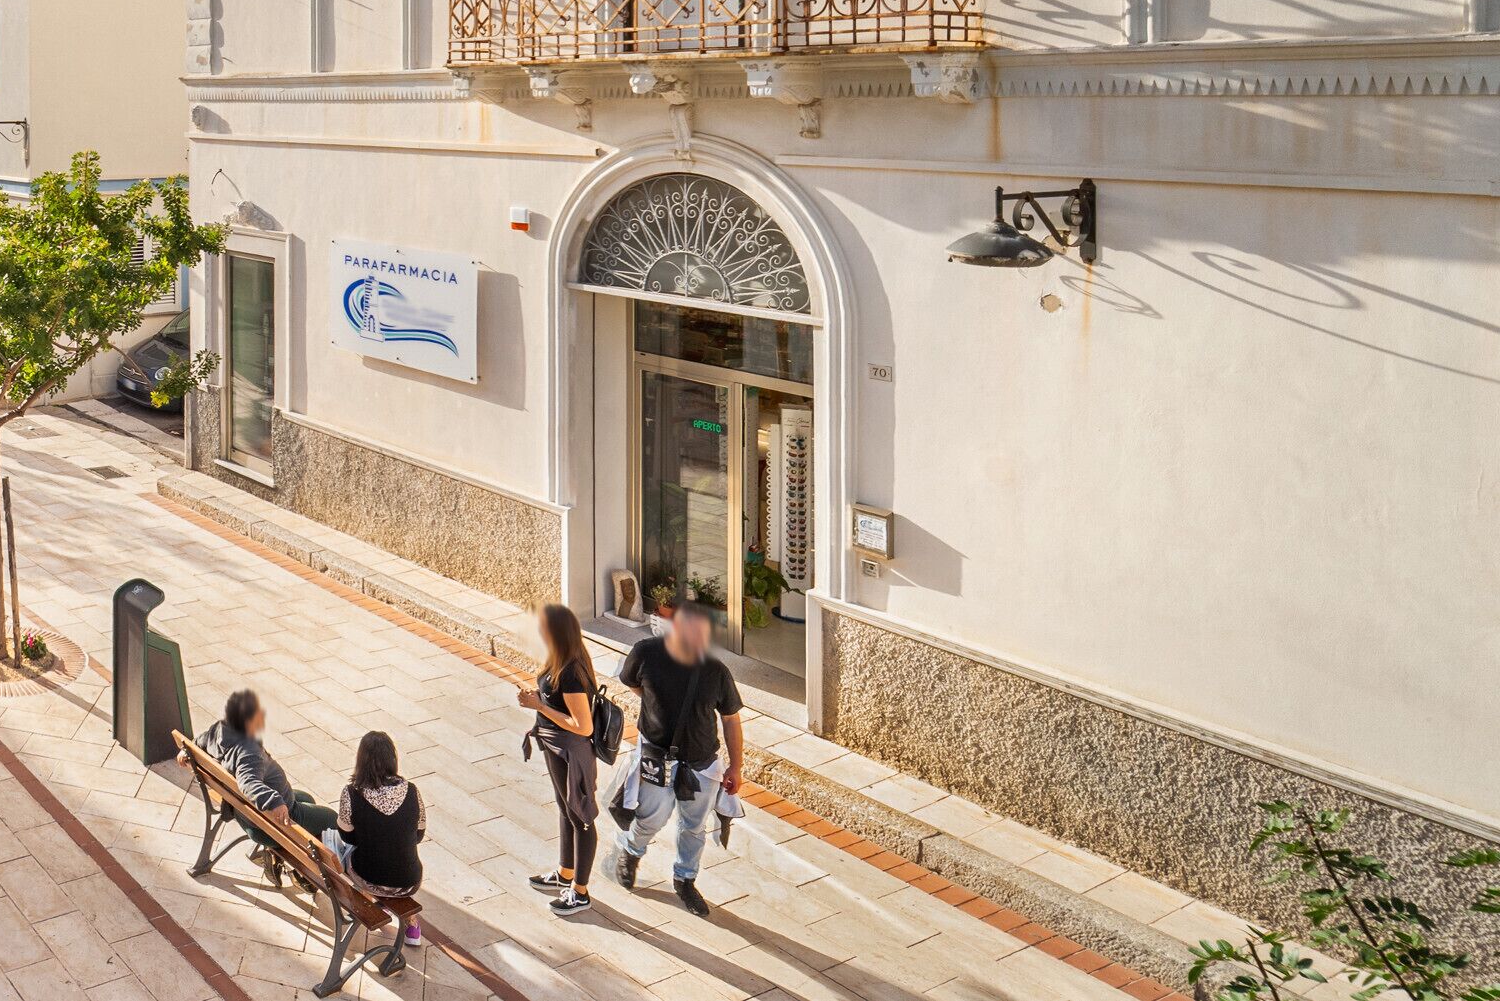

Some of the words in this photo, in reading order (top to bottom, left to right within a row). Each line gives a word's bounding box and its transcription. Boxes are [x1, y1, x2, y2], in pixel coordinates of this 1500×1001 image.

[344, 254, 458, 285] PARAFARMACIA
[872, 367, 887, 378] 70
[693, 418, 722, 433] APERTO
